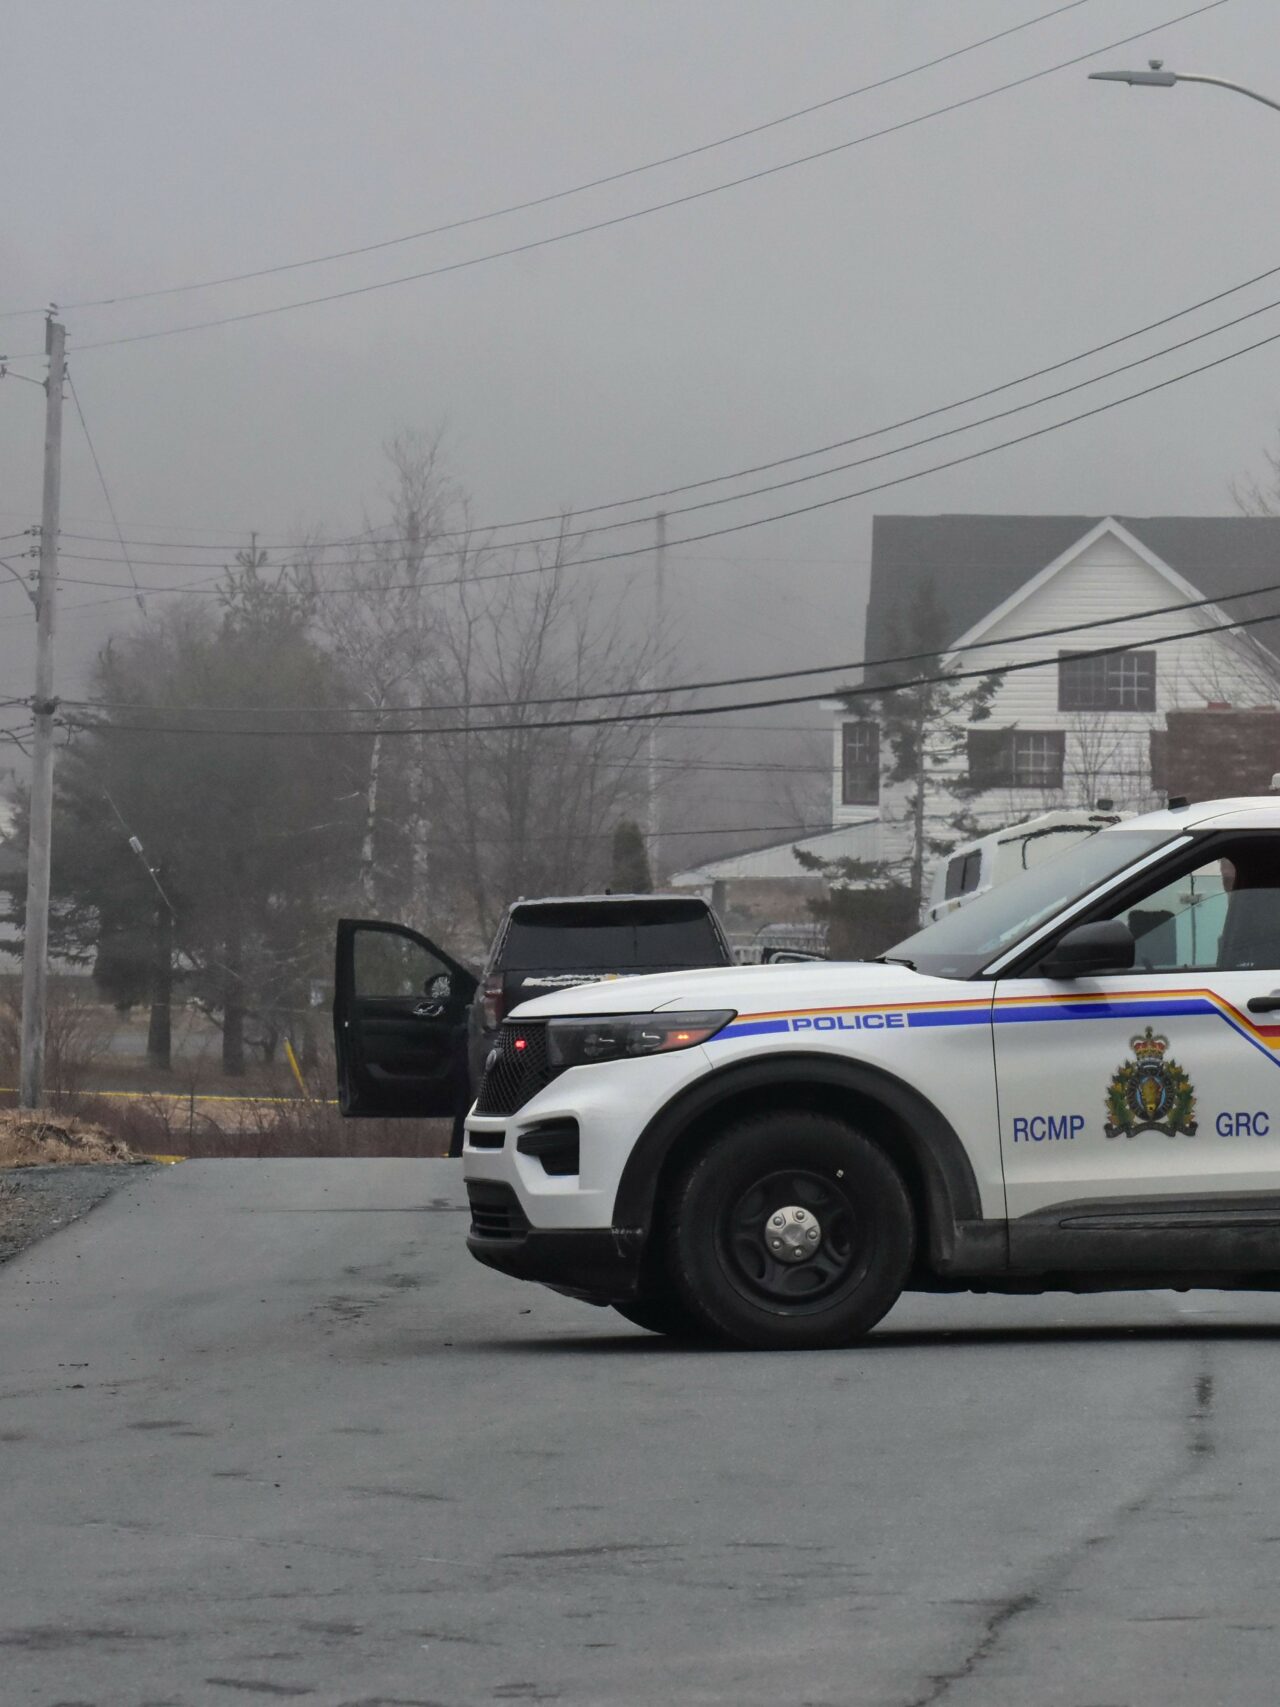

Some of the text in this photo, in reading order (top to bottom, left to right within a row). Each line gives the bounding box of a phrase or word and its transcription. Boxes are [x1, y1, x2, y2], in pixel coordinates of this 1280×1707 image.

[791, 1013, 905, 1032] POLICE
[1013, 1115, 1085, 1142] RCMP
[1215, 1111, 1270, 1137] GRC
